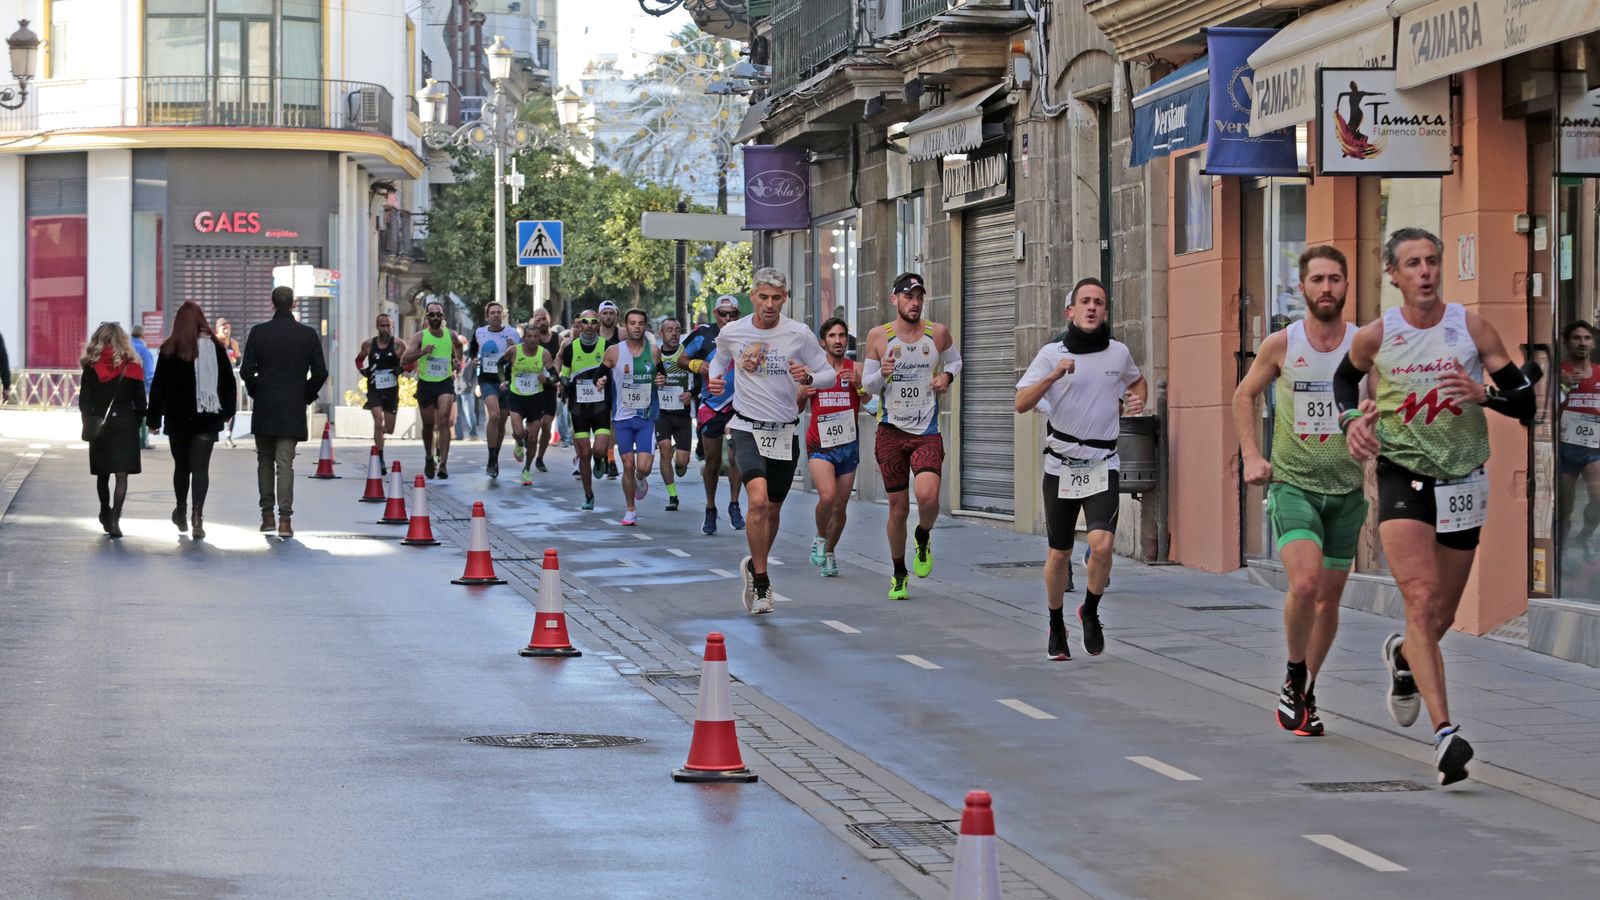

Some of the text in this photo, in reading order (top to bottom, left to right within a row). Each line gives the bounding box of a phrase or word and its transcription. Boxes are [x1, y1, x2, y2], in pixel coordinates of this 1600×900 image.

[1409, 2, 1483, 66] TAMARA
[1256, 64, 1307, 120] TAMARA
[1364, 101, 1446, 126] Tamara
[1373, 127, 1447, 137] Flamenco Dance
[974, 152, 1006, 192] NANDO
[194, 211, 261, 234] GAES
[1391, 357, 1457, 376] marató
[581, 388, 594, 396] 386
[627, 393, 641, 401] 156
[901, 387, 920, 398] 820
[1307, 401, 1333, 418] 831
[826, 424, 844, 436] 450
[760, 436, 777, 448] 227
[1449, 494, 1473, 513] 838
